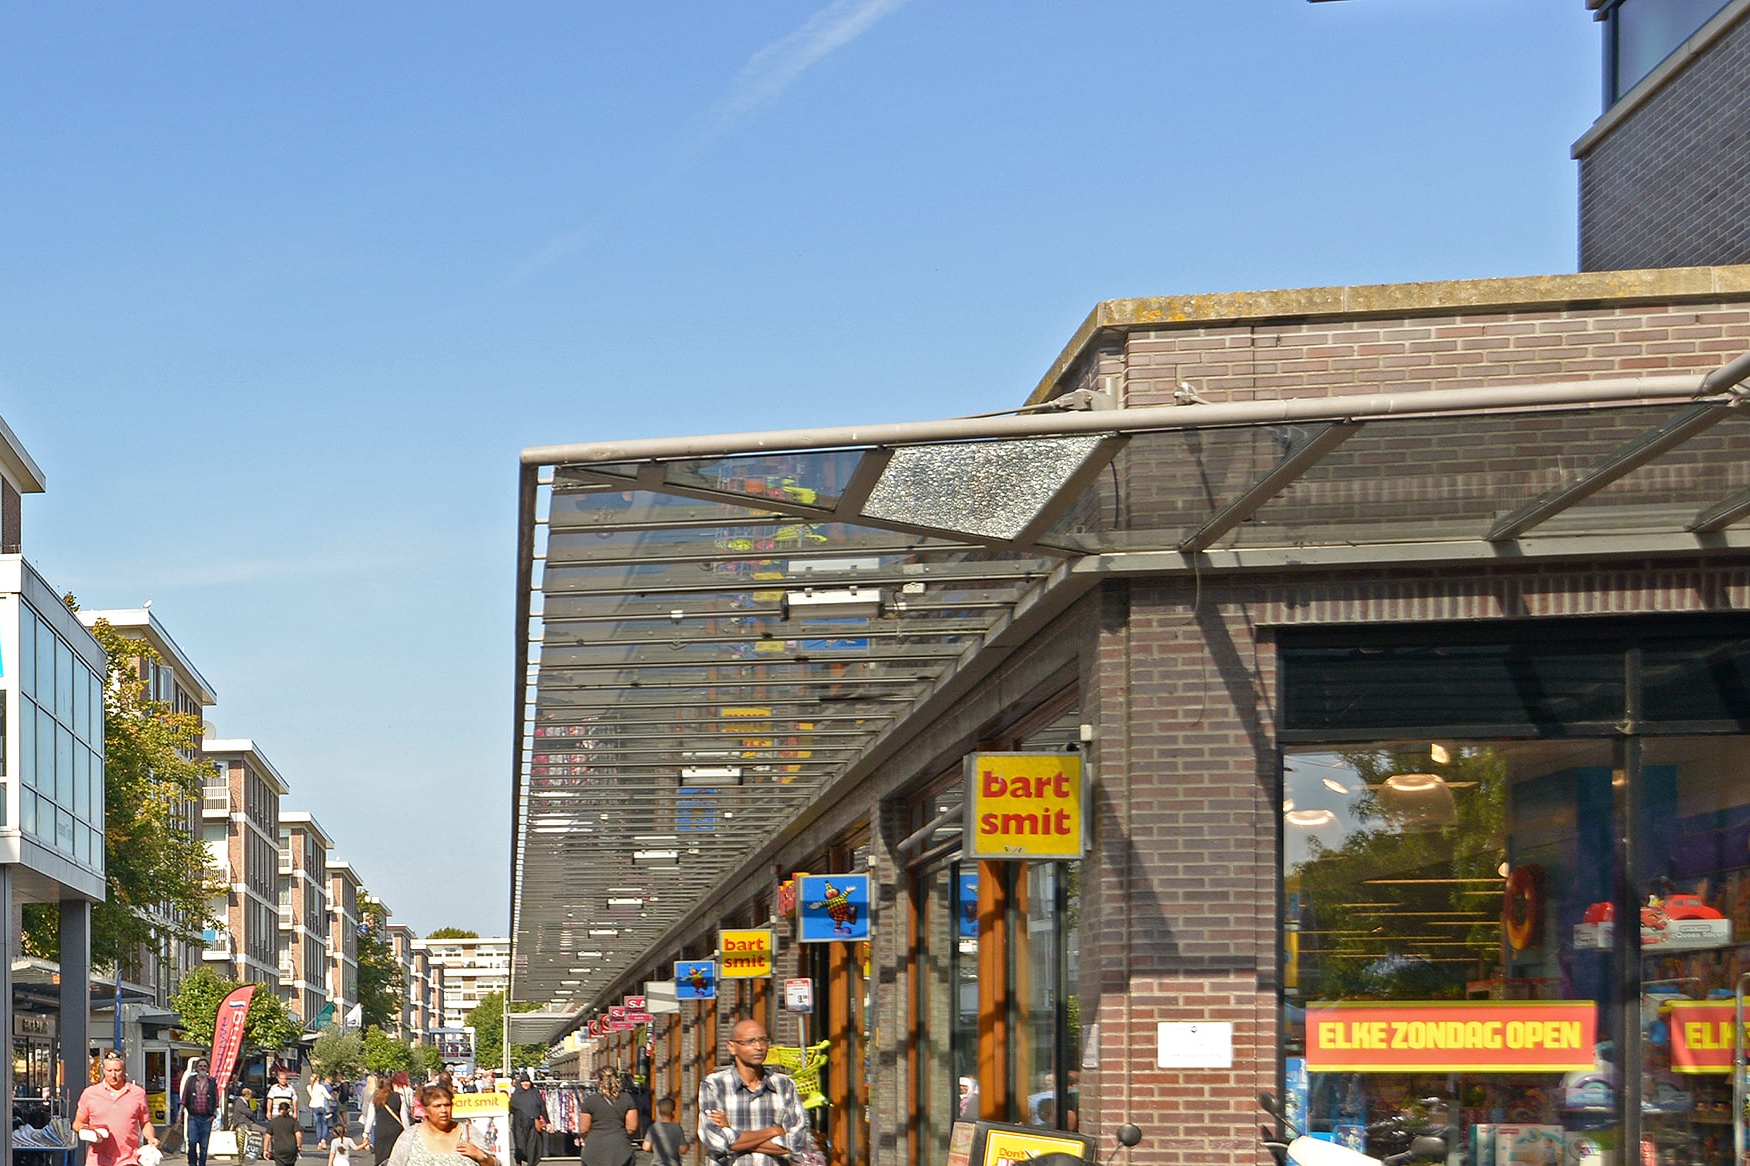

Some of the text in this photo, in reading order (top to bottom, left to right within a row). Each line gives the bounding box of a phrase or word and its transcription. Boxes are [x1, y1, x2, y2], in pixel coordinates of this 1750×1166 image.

[982, 770, 1070, 798] bart
[980, 807, 1071, 835] smit
[724, 938, 764, 951] bart
[724, 955, 765, 968] smit
[1318, 1021, 1582, 1050] ELKE ZONDAG OPEN
[474, 1095, 499, 1108] smit
[998, 1147, 1026, 1159] Don't
